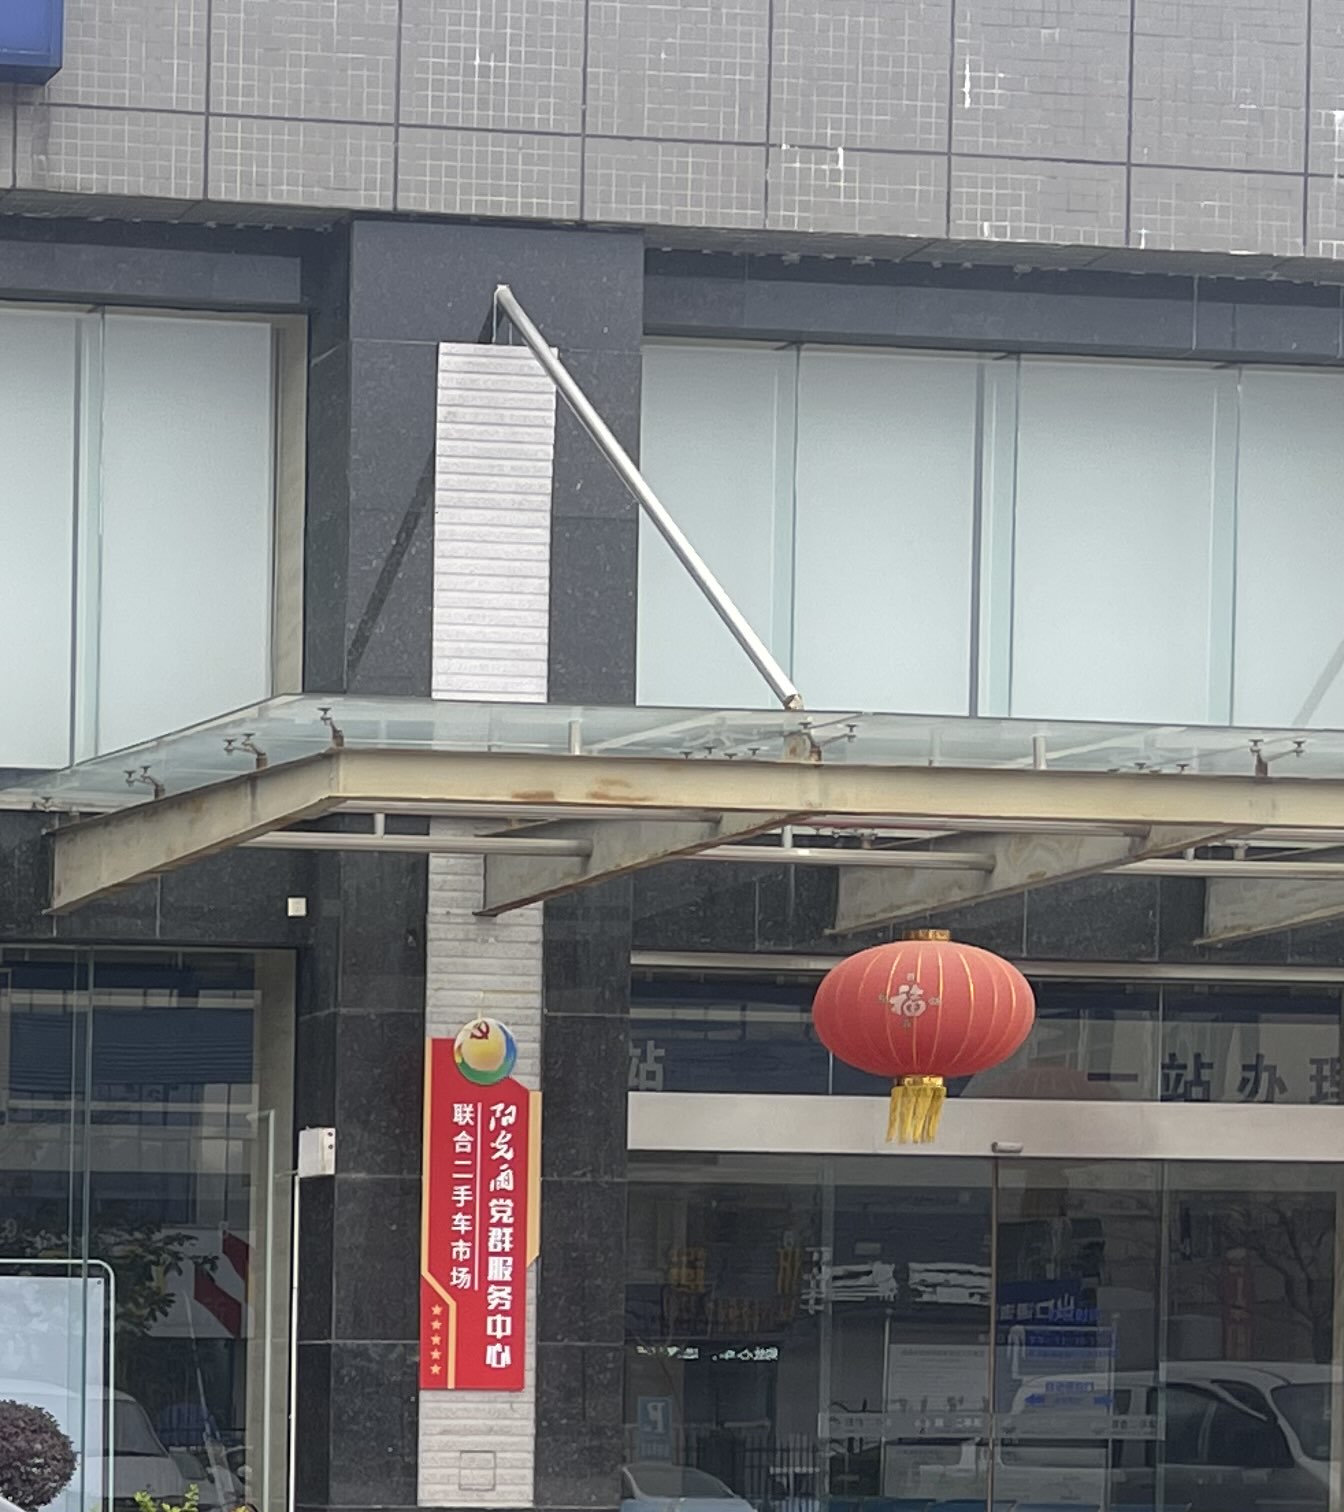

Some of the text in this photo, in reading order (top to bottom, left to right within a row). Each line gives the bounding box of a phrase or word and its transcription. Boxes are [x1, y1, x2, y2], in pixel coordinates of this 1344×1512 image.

[449, 1103, 474, 1290] 联合二手车市场
